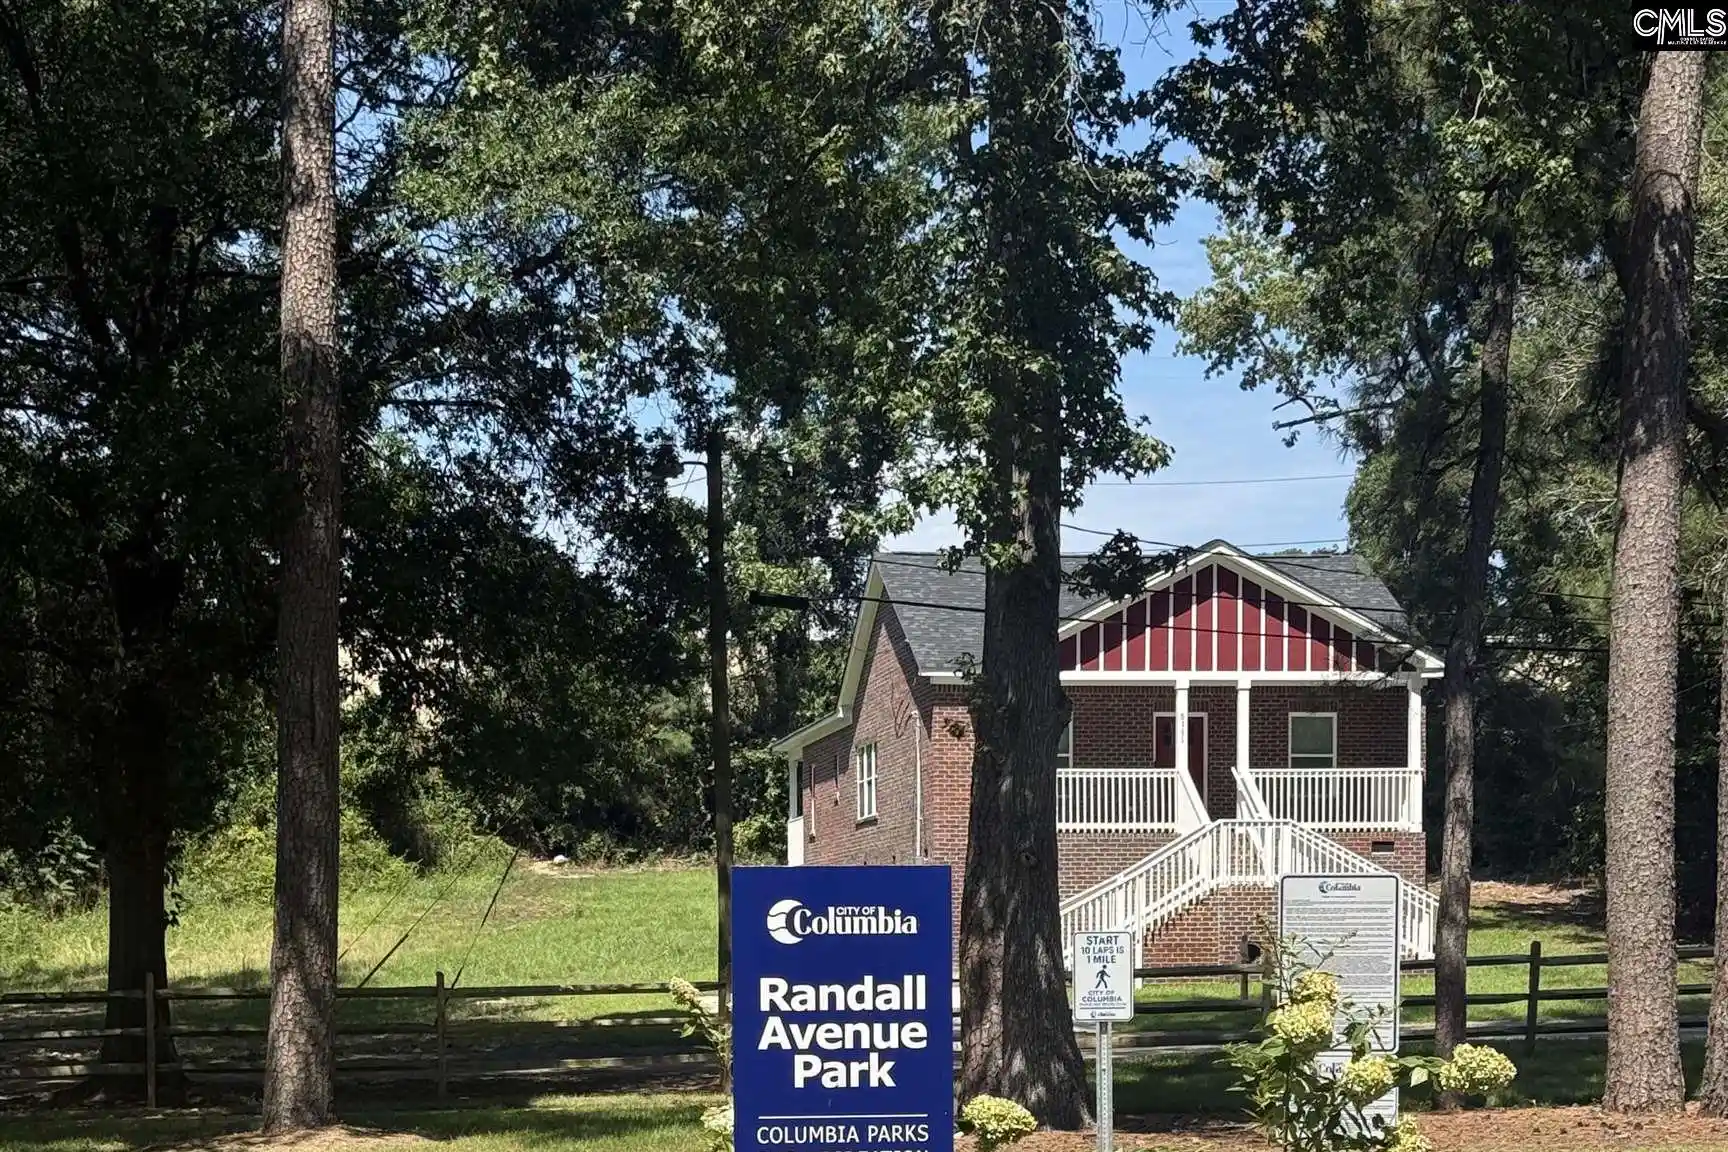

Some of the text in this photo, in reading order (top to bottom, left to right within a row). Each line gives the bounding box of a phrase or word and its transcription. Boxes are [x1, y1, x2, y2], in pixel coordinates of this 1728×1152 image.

[794, 907, 918, 935] Columbia
[837, 907, 876, 915] CITY OF
[1081, 946, 1125, 954] 10 LAPS IS
[1086, 935, 1119, 945] START
[1087, 955, 1117, 964] 1 MILE
[760, 975, 926, 1012] Randall
[758, 1016, 928, 1050] Avenue
[794, 1053, 897, 1089] Park
[757, 1124, 929, 1144] COLUMBIA PARKS
